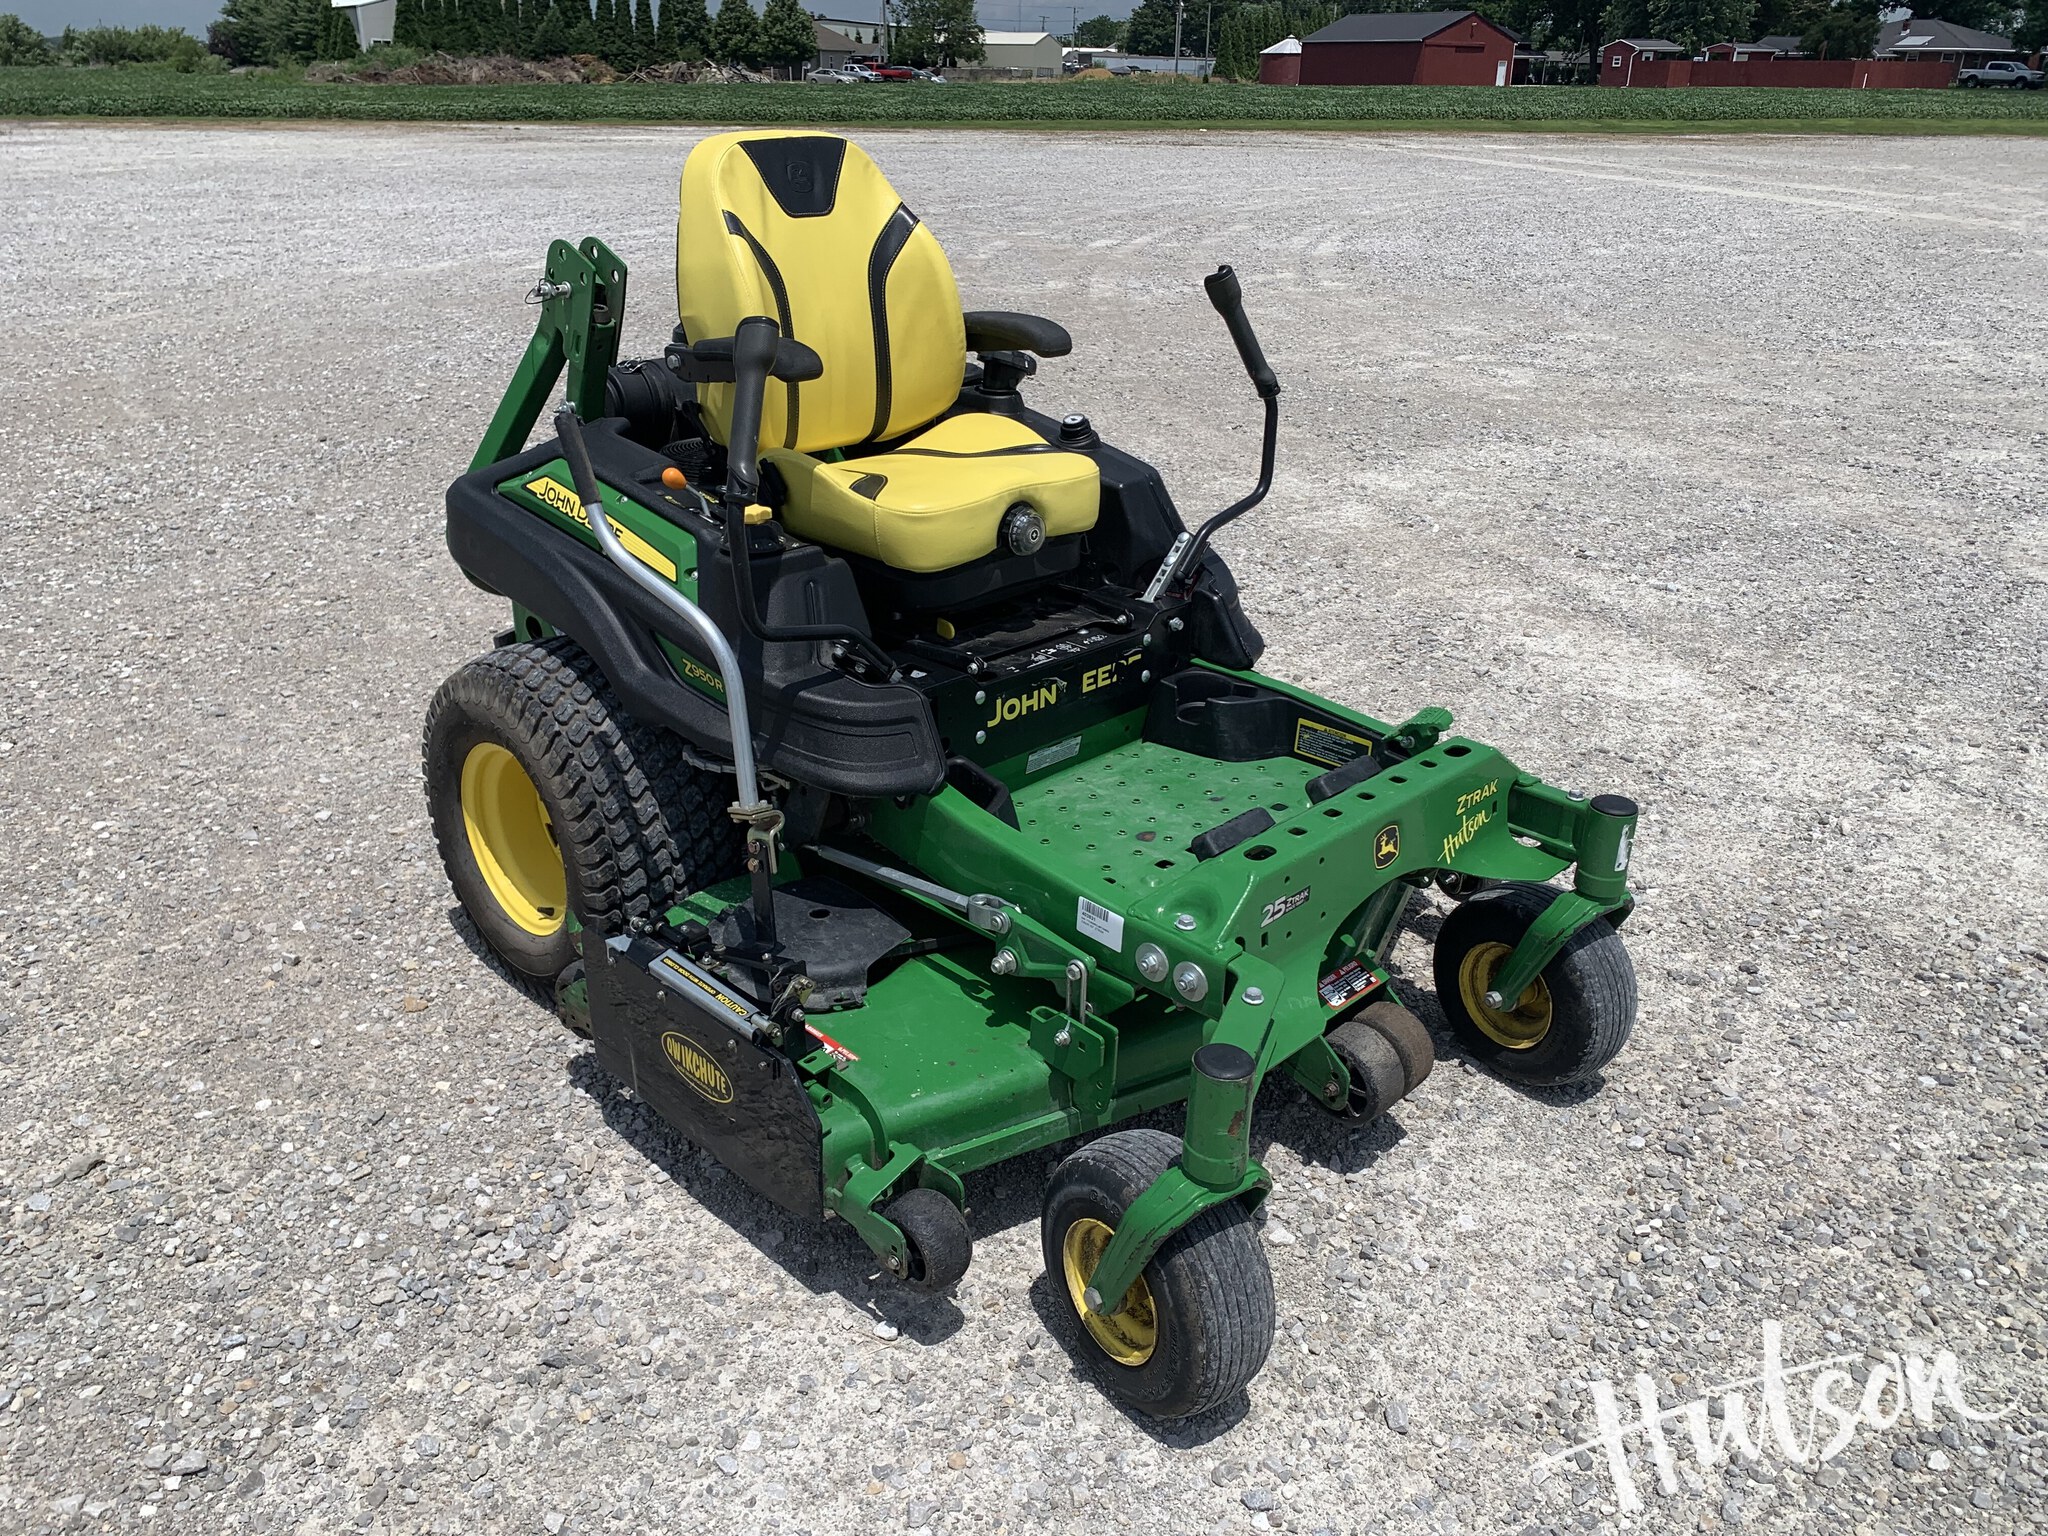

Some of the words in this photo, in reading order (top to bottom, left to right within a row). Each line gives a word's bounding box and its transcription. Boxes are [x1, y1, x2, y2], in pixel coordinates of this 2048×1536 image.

[539, 481, 576, 515] JOHN
[682, 658, 724, 693] Z950R
[987, 683, 1057, 728] JOHN
[1456, 778, 1499, 816] ZTRAK
[1437, 809, 1493, 865] Hutson
[1260, 895, 1287, 928] 25
[715, 993, 748, 1016] CAUTION
[666, 1036, 727, 1095] QWIKCHUTE
